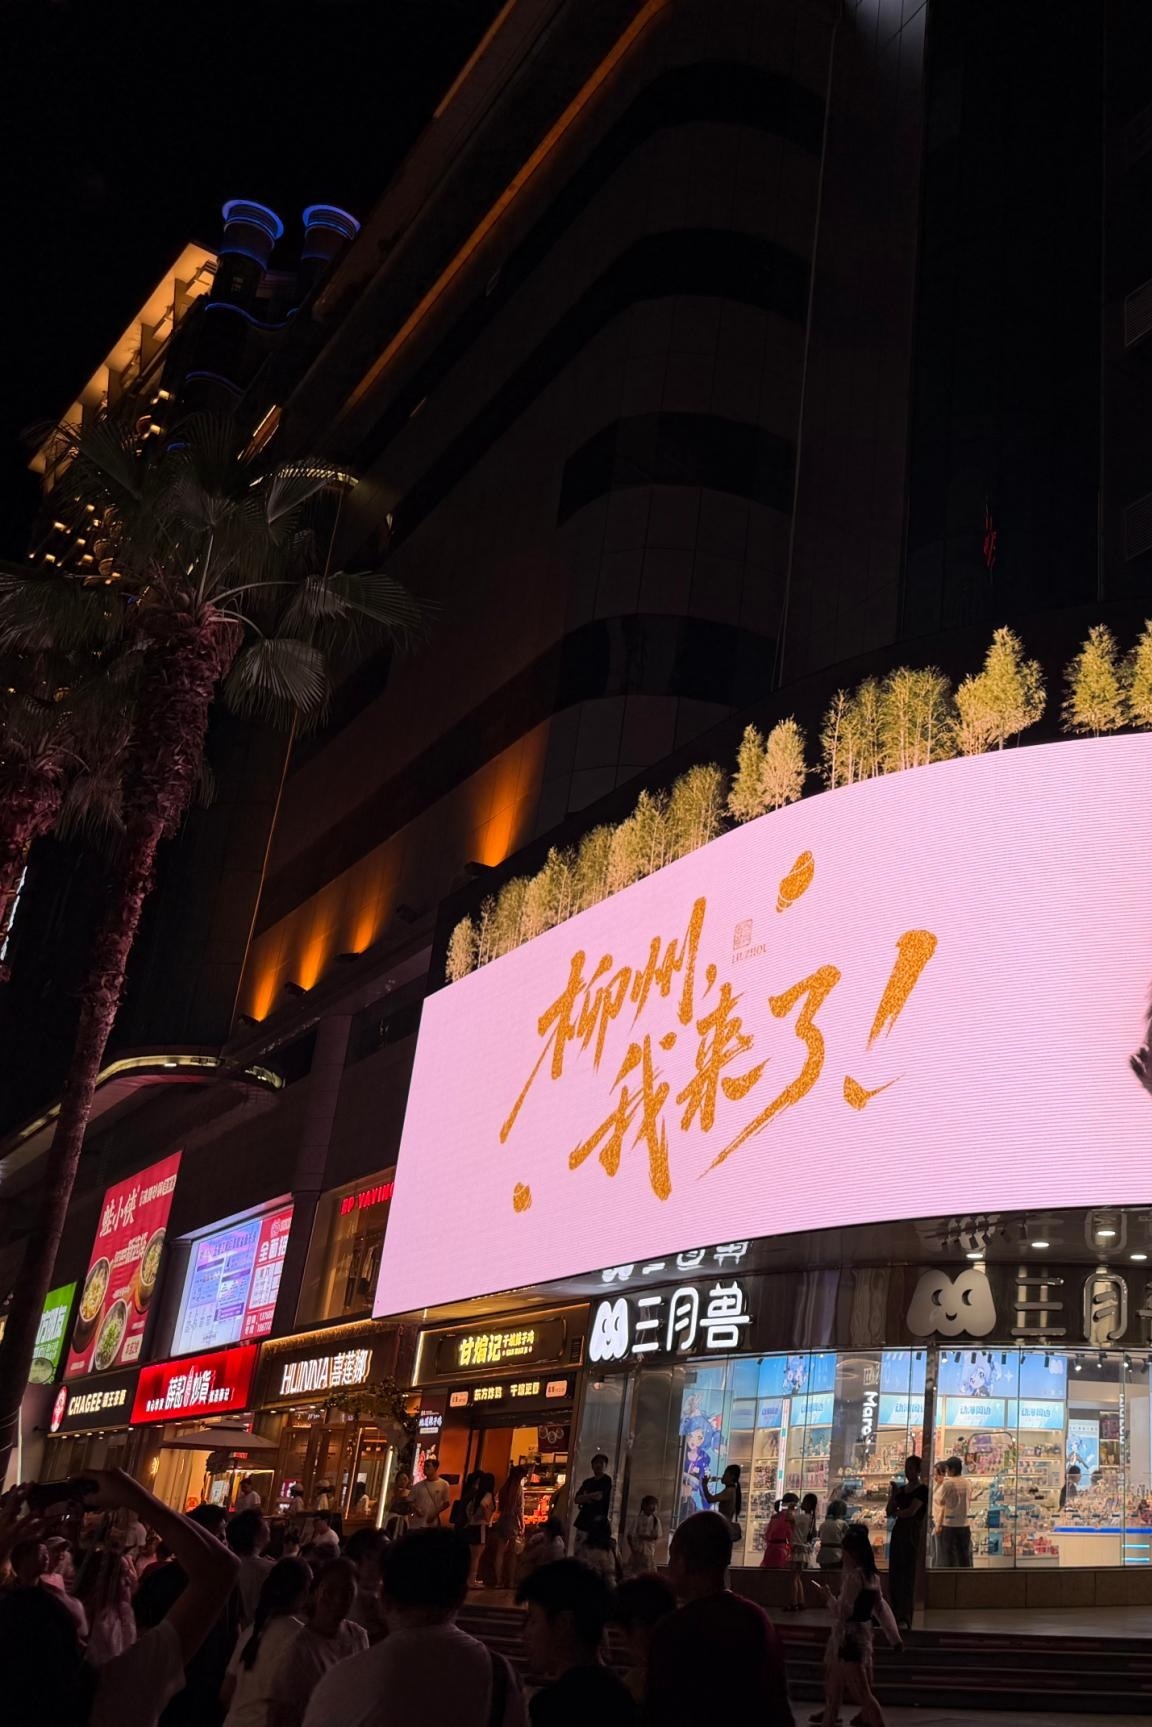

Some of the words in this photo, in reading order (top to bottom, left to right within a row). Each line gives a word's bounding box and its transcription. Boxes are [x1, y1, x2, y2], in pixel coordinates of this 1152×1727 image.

[632, 1280, 750, 1353] 三月兽
[68, 1391, 103, 1416] CHAGEE
